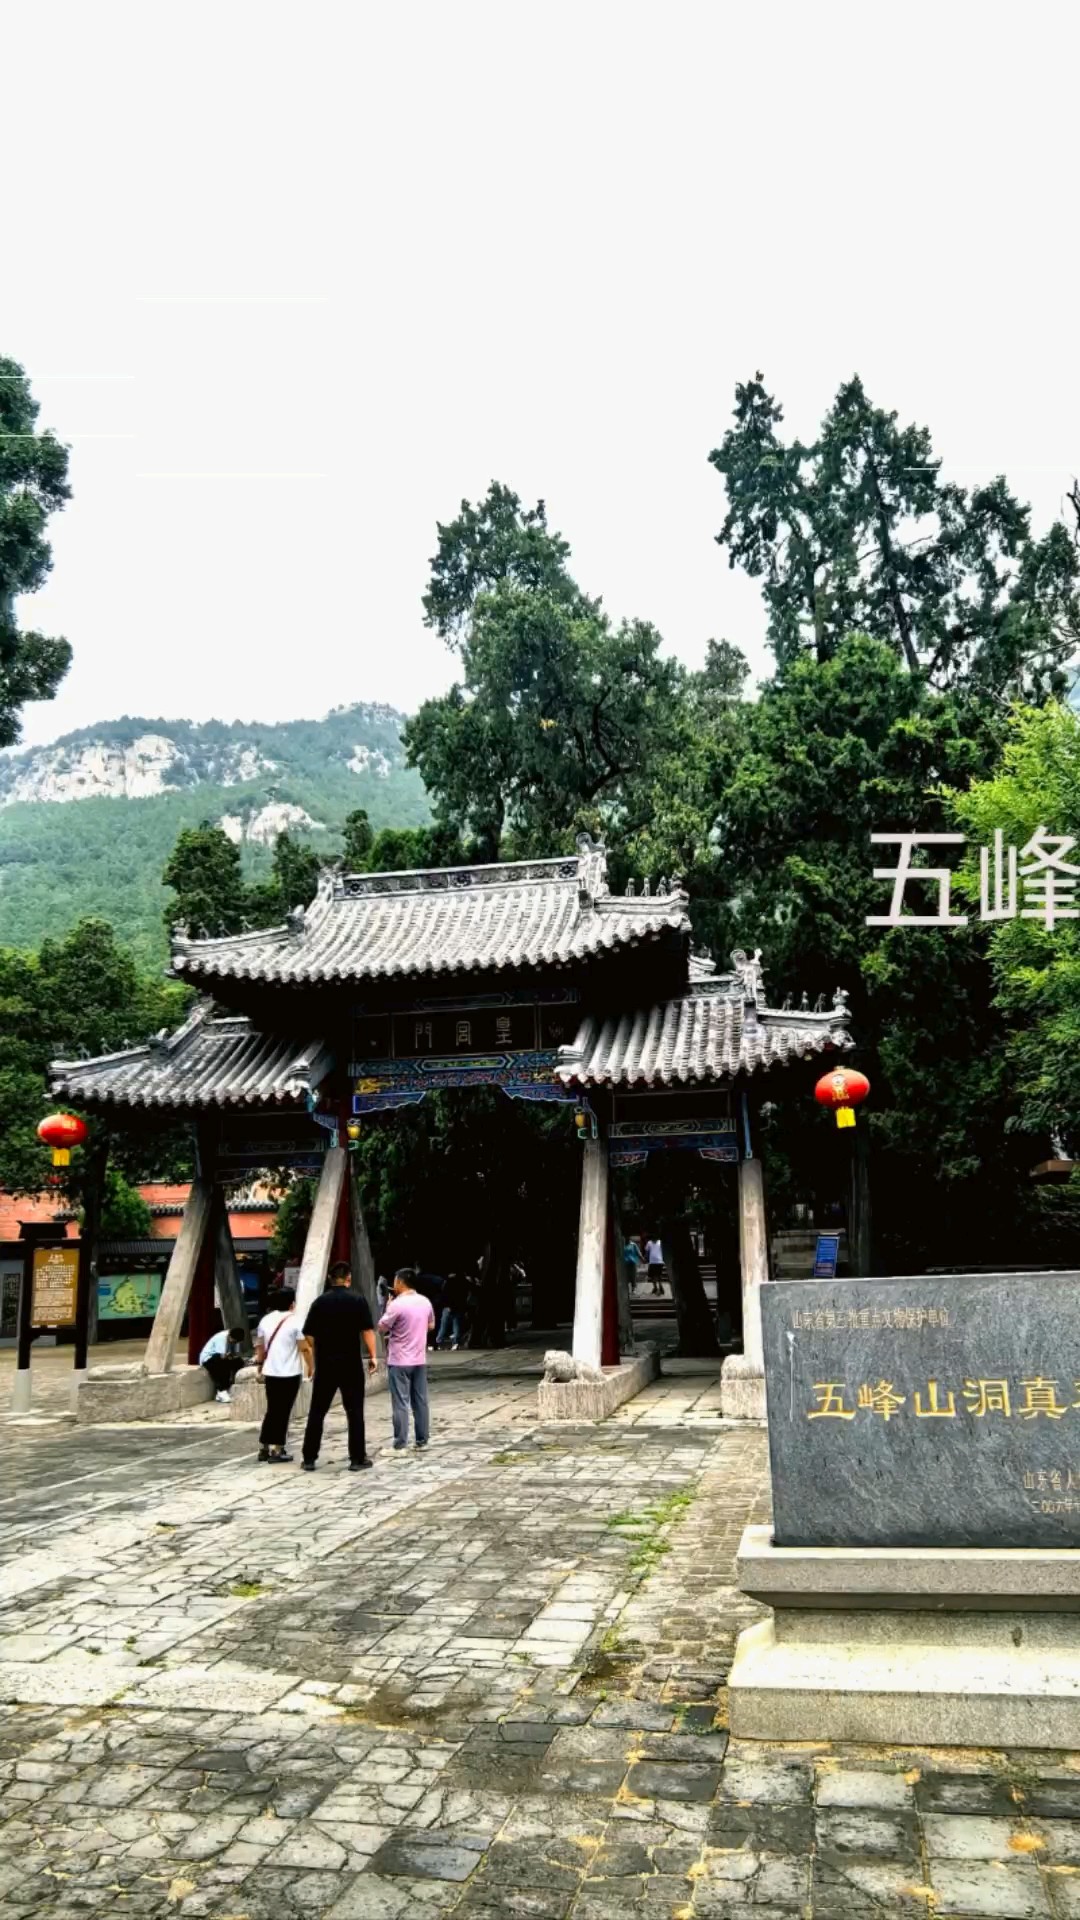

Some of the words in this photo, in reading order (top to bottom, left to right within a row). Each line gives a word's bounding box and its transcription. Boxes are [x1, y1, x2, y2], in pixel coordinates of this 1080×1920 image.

[806, 1376, 1080, 1421] 五峰山洞真
